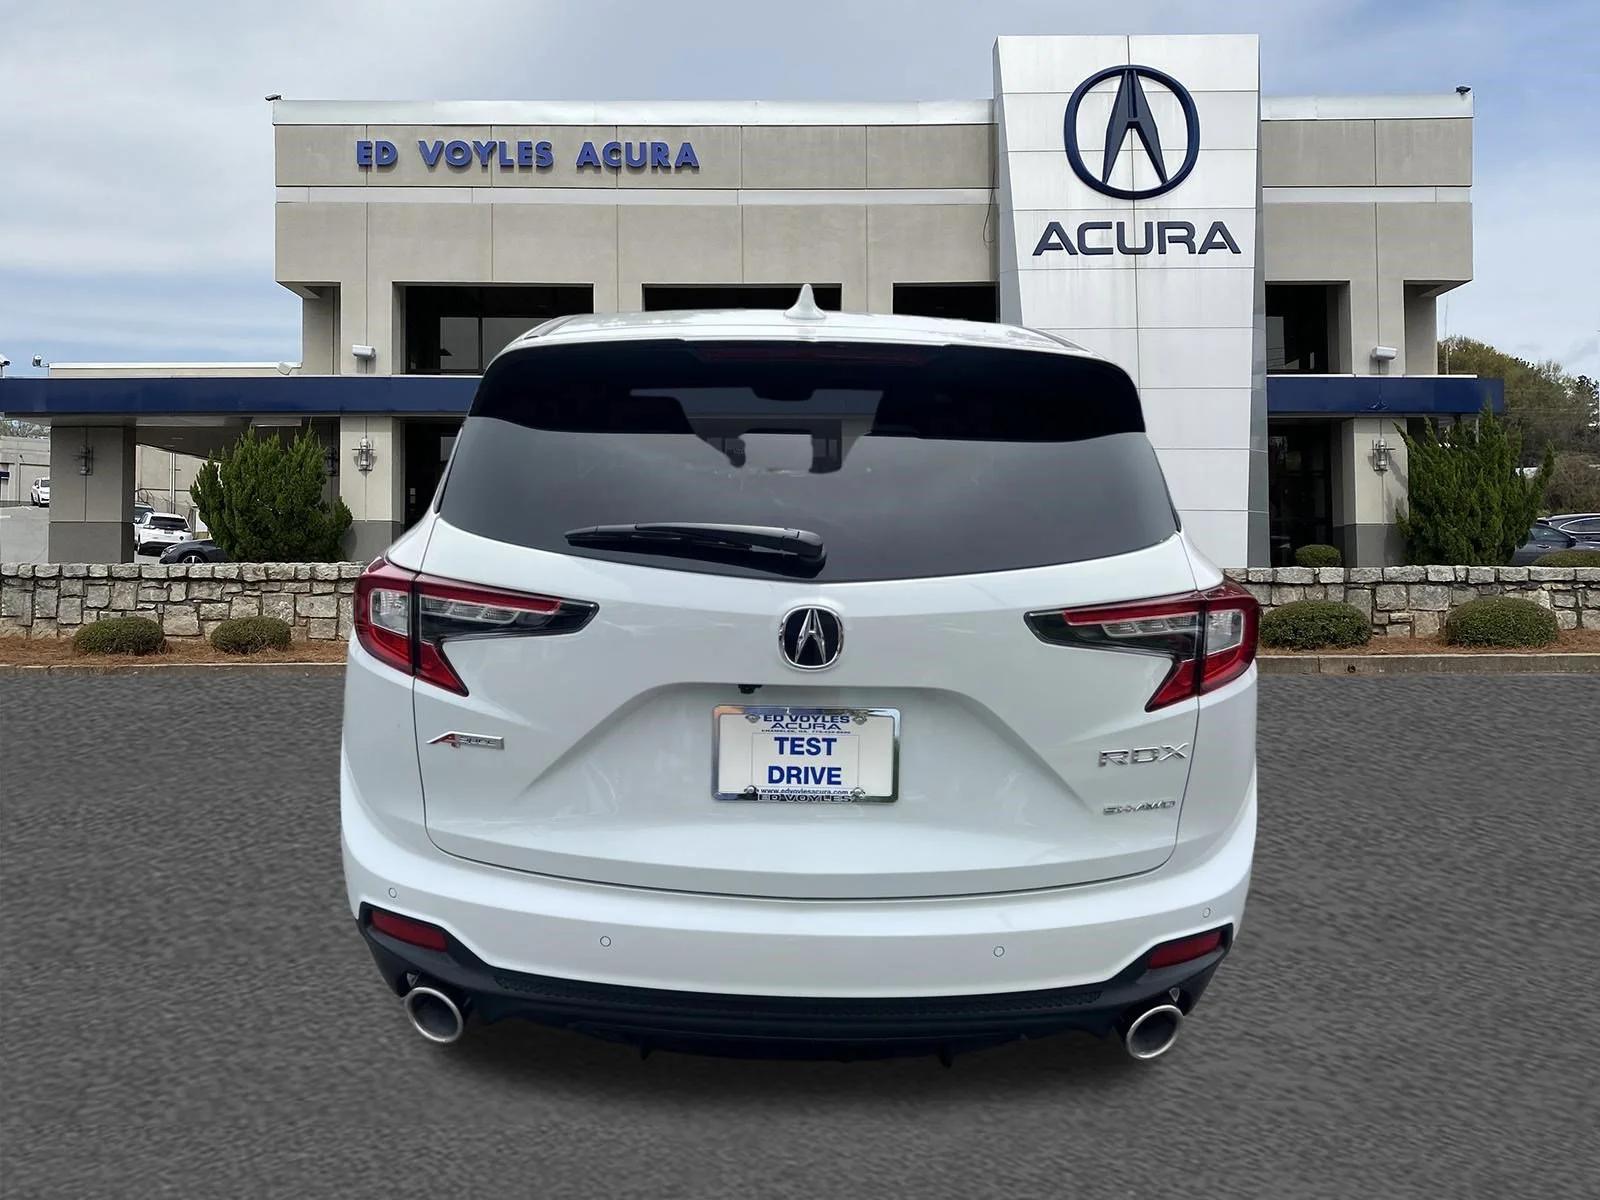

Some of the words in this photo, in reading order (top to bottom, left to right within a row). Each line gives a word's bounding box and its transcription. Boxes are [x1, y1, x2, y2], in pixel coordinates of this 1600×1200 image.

[356, 140, 398, 167] ED
[418, 140, 555, 168] VOYLES
[576, 141, 701, 169] ACURA
[1032, 221, 1242, 256] ACURA
[763, 714, 784, 722] ED
[789, 714, 850, 723] VOYLES
[771, 722, 841, 730] ACURA
[774, 737, 837, 755] TEST
[1098, 742, 1190, 767] RDX
[768, 766, 841, 785] DRIVE
